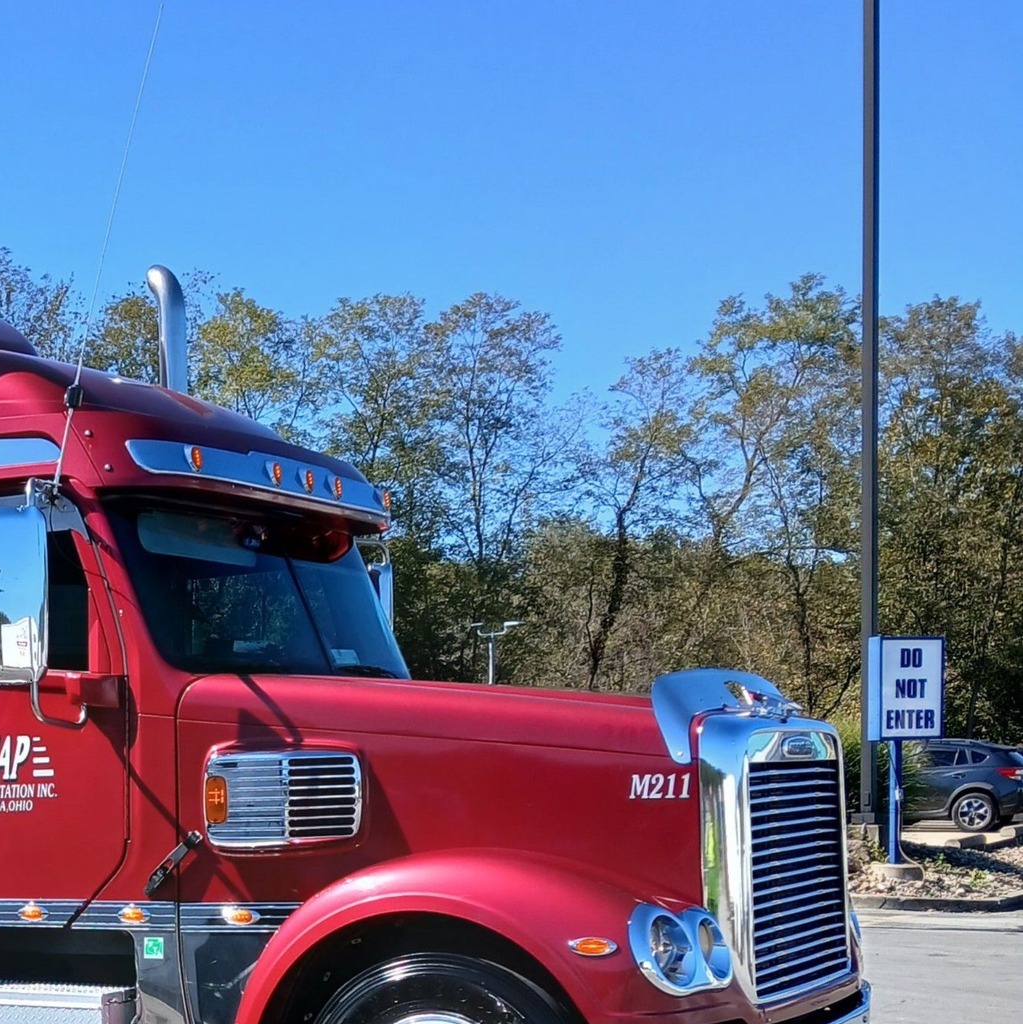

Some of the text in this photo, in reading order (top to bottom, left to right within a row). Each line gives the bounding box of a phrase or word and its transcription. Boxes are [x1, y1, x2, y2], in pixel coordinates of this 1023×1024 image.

[900, 648, 923, 668] DO
[895, 679, 927, 698] NOT
[886, 709, 935, 729] ENTER
[37, 783, 58, 797] INC.
[629, 773, 691, 799] M211
